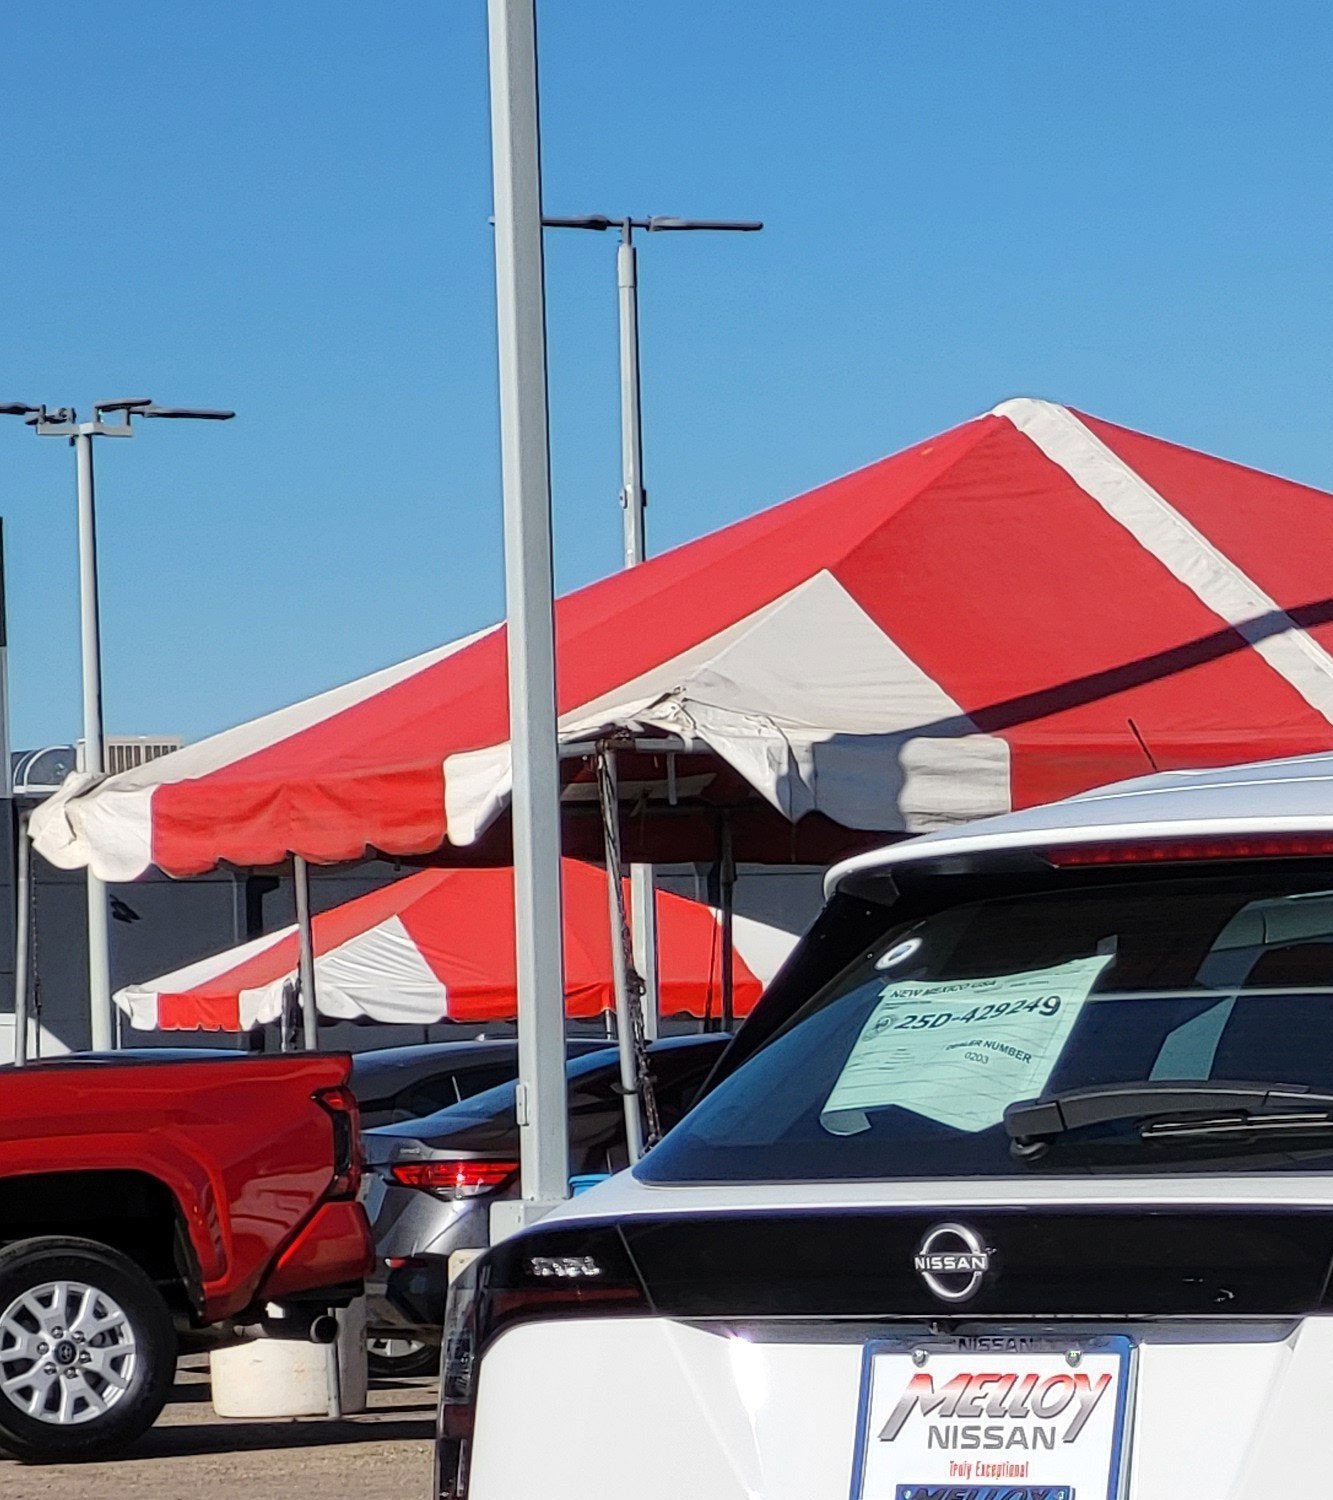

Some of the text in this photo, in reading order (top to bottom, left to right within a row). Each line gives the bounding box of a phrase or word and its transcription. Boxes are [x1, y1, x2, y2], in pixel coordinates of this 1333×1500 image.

[889, 988, 923, 999] NEW
[894, 996, 1061, 1029] 25D-429249
[984, 1040, 1033, 1064] NUMBER
[914, 1255, 987, 1270] NISSAN
[957, 1337, 1034, 1352] NISSAN
[877, 1372, 1112, 1443] MELLOY
[927, 1425, 1056, 1450] NISSAN
[949, 1460, 1029, 1479] Truly Exceptional
